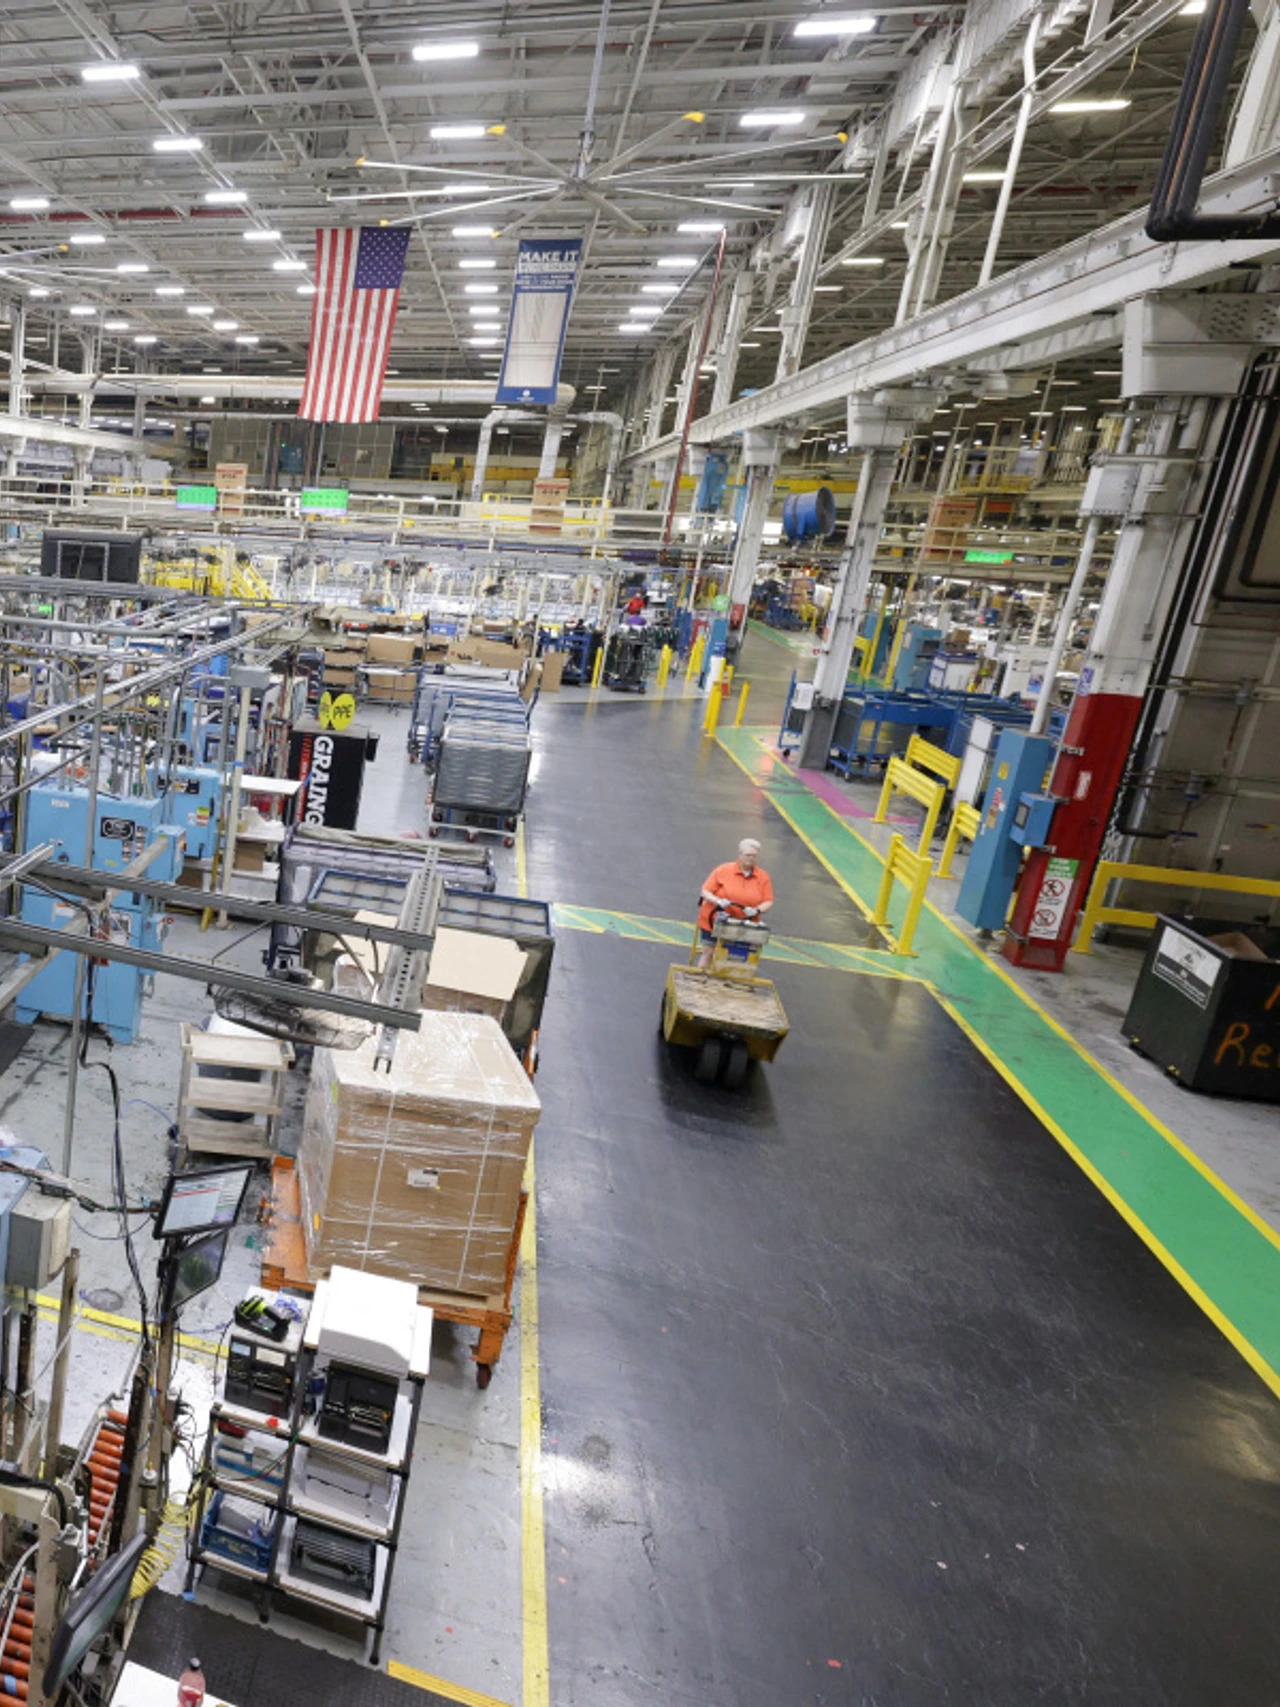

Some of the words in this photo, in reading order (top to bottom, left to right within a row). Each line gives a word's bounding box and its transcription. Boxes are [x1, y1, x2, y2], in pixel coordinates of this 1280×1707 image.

[519, 250, 561, 262] MAKE
[564, 249, 579, 262] IT
[333, 703, 354, 720] PPE
[1214, 1022, 1280, 1068] Re
